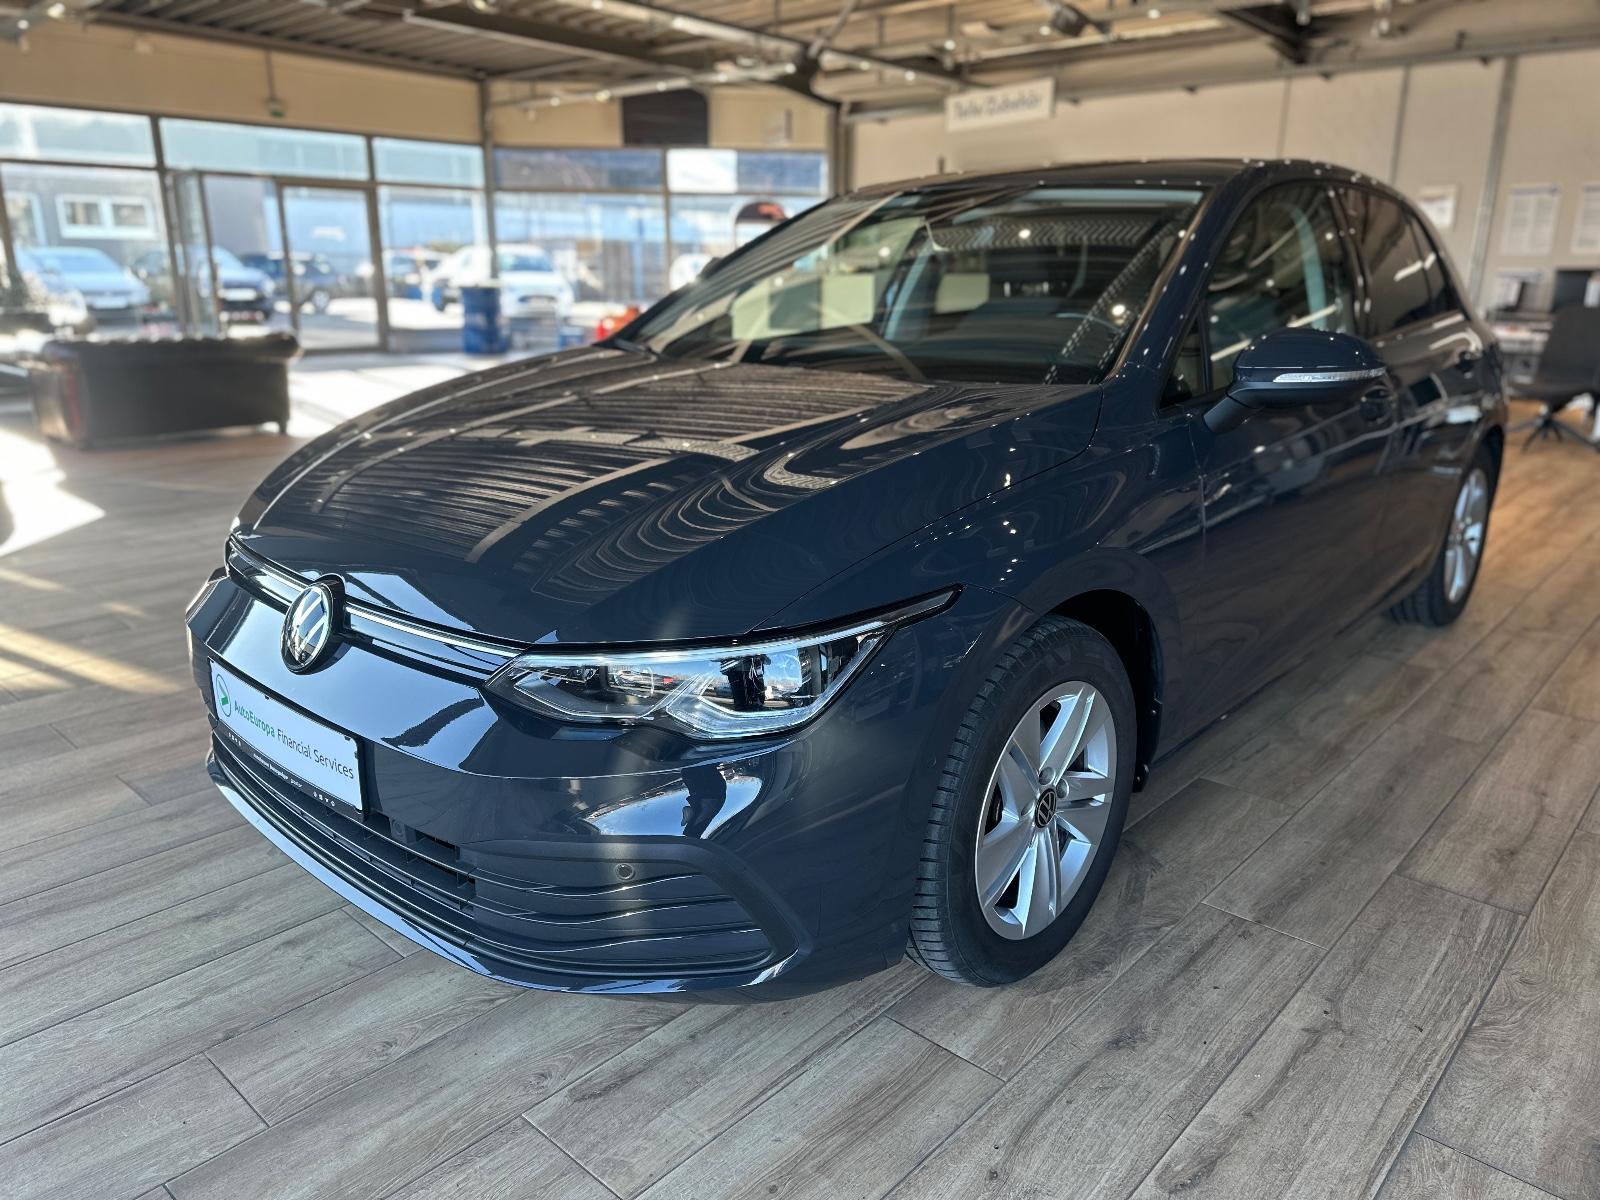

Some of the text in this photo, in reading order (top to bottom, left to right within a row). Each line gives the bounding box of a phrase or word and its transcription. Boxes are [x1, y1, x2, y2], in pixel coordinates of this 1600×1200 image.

[234, 699, 276, 738] AutoEuropa
[277, 728, 312, 759] Financial
[313, 749, 354, 779] Services
